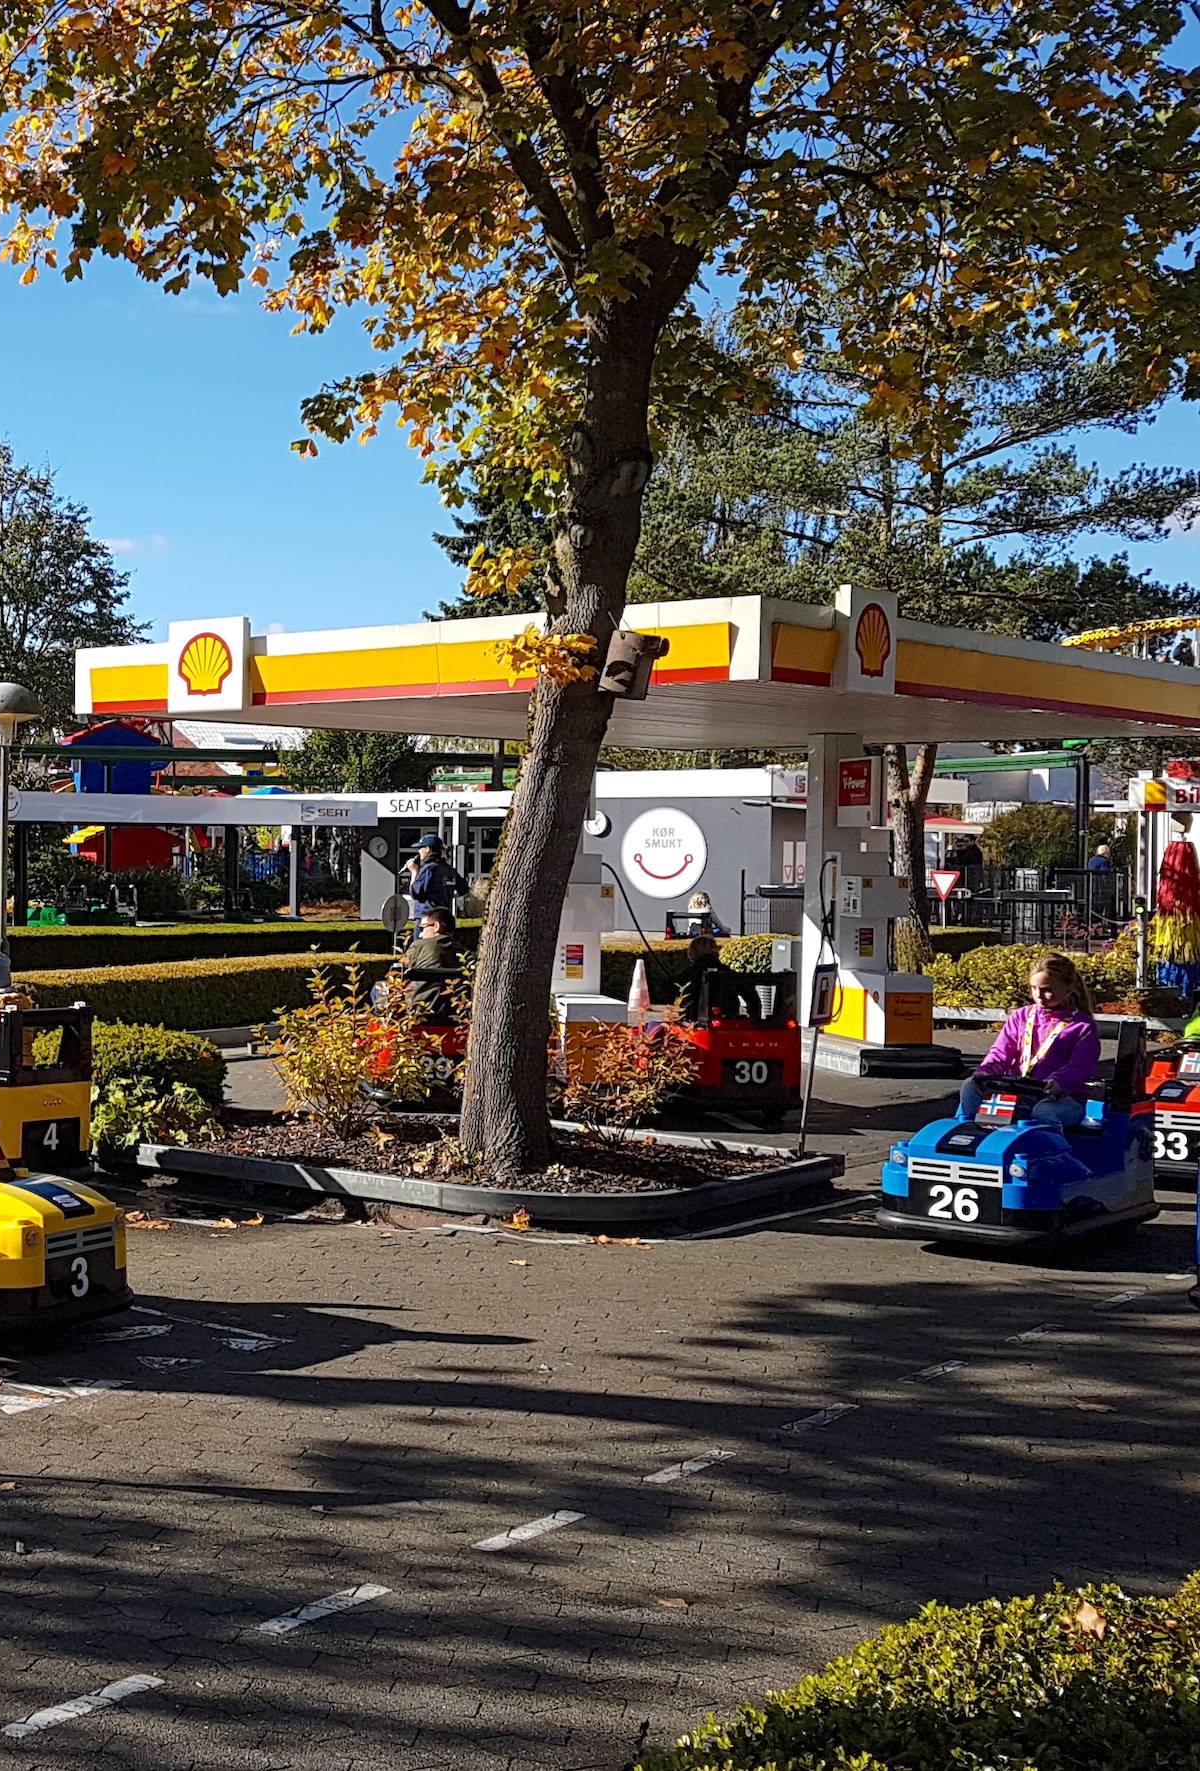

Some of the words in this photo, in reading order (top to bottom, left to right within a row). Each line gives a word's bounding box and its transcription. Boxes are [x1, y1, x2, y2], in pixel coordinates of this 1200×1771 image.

[317, 808, 351, 817] SEAT
[390, 799, 421, 812] SEAT
[652, 827, 675, 838] KØR
[644, 839, 683, 849] SMUKT
[734, 1060, 768, 1084] 30
[43, 1122, 59, 1151] 4
[928, 1184, 979, 1222] 26
[71, 1256, 90, 1298] 3
